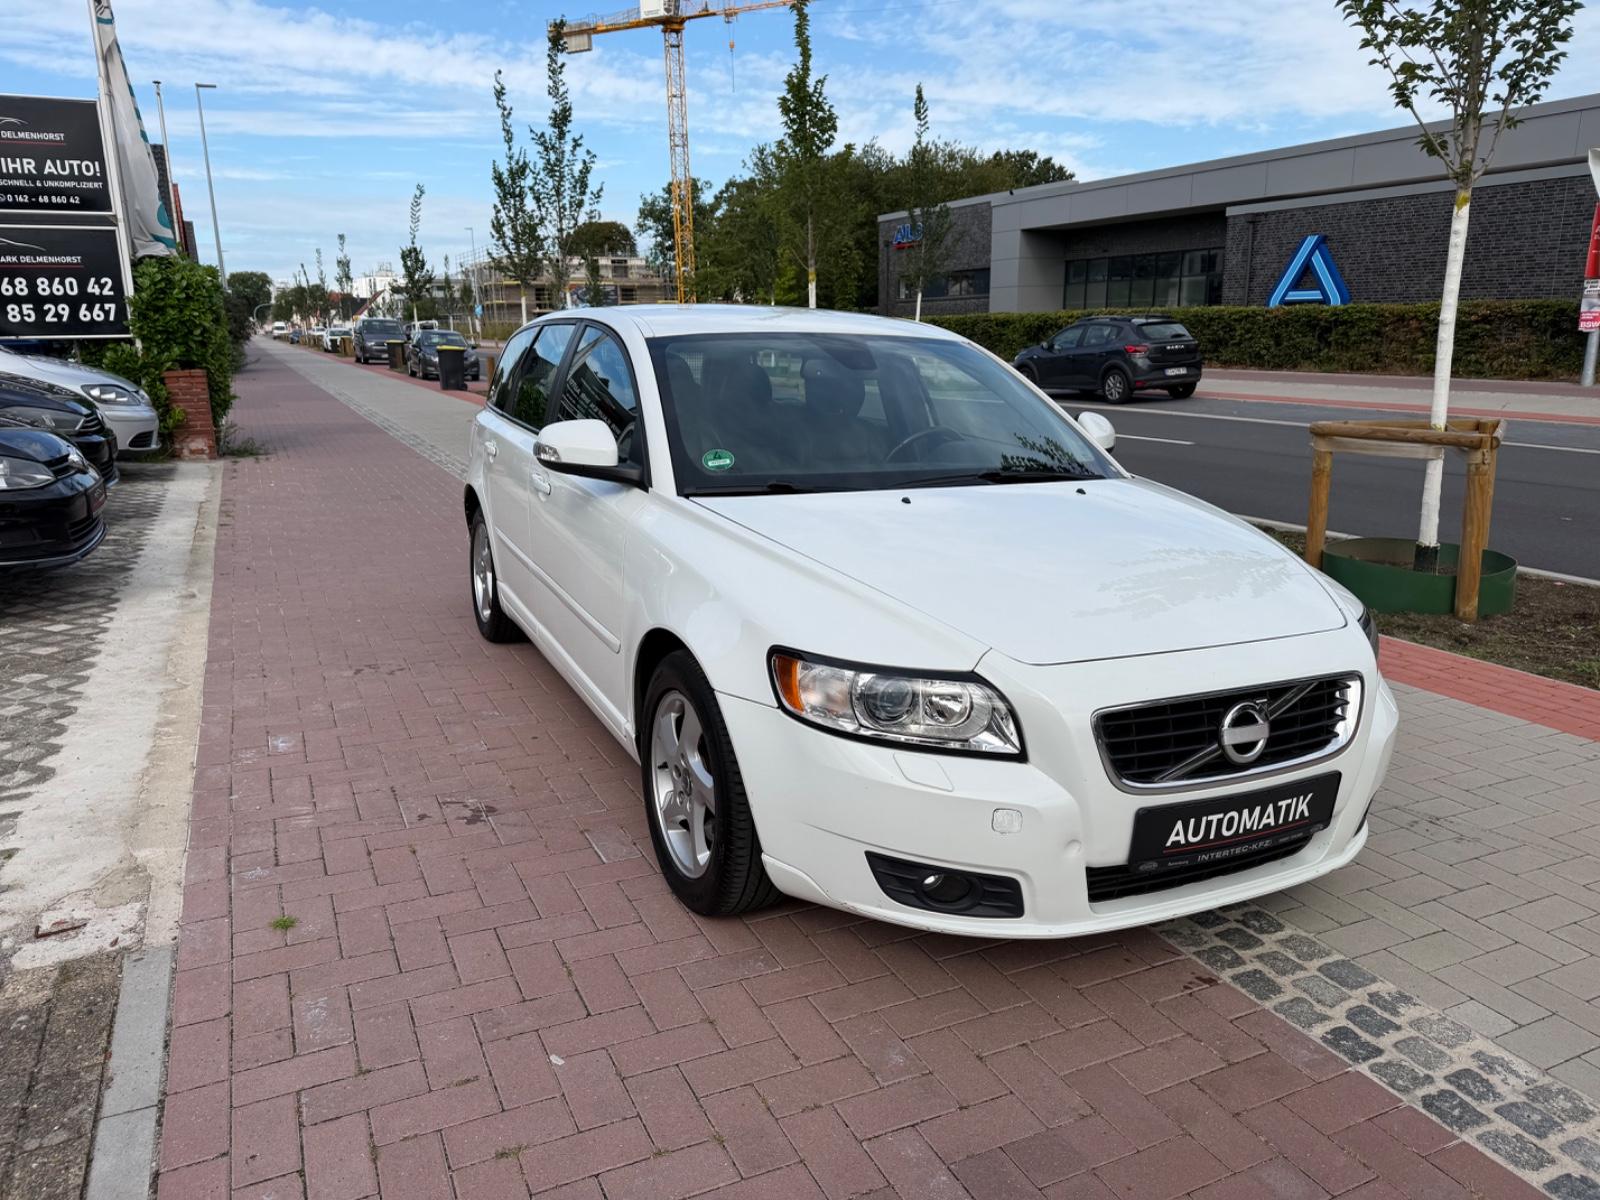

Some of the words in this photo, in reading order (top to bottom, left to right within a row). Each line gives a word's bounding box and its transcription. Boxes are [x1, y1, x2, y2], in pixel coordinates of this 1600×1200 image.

[1, 130, 65, 141] DELMENHORST
[0, 157, 37, 175] IHR
[43, 158, 101, 177] AUTO!
[43, 180, 104, 189] UNKOMPLIZIERT
[7, 194, 13, 202] 0
[14, 194, 29, 203] 162
[38, 195, 49, 203] 68
[51, 195, 67, 204] 860
[69, 196, 80, 204] 42
[20, 255, 82, 263] DELMENHORST
[0, 277, 29, 296] 68
[36, 277, 79, 296] 860
[87, 277, 115, 296] 42
[6, 303, 36, 323] 85
[43, 303, 70, 323] 29
[79, 303, 116, 322] 667
[1165, 792, 1314, 847] AUTOMATIK
[1197, 839, 1272, 863] INTERTEC-KFZ
